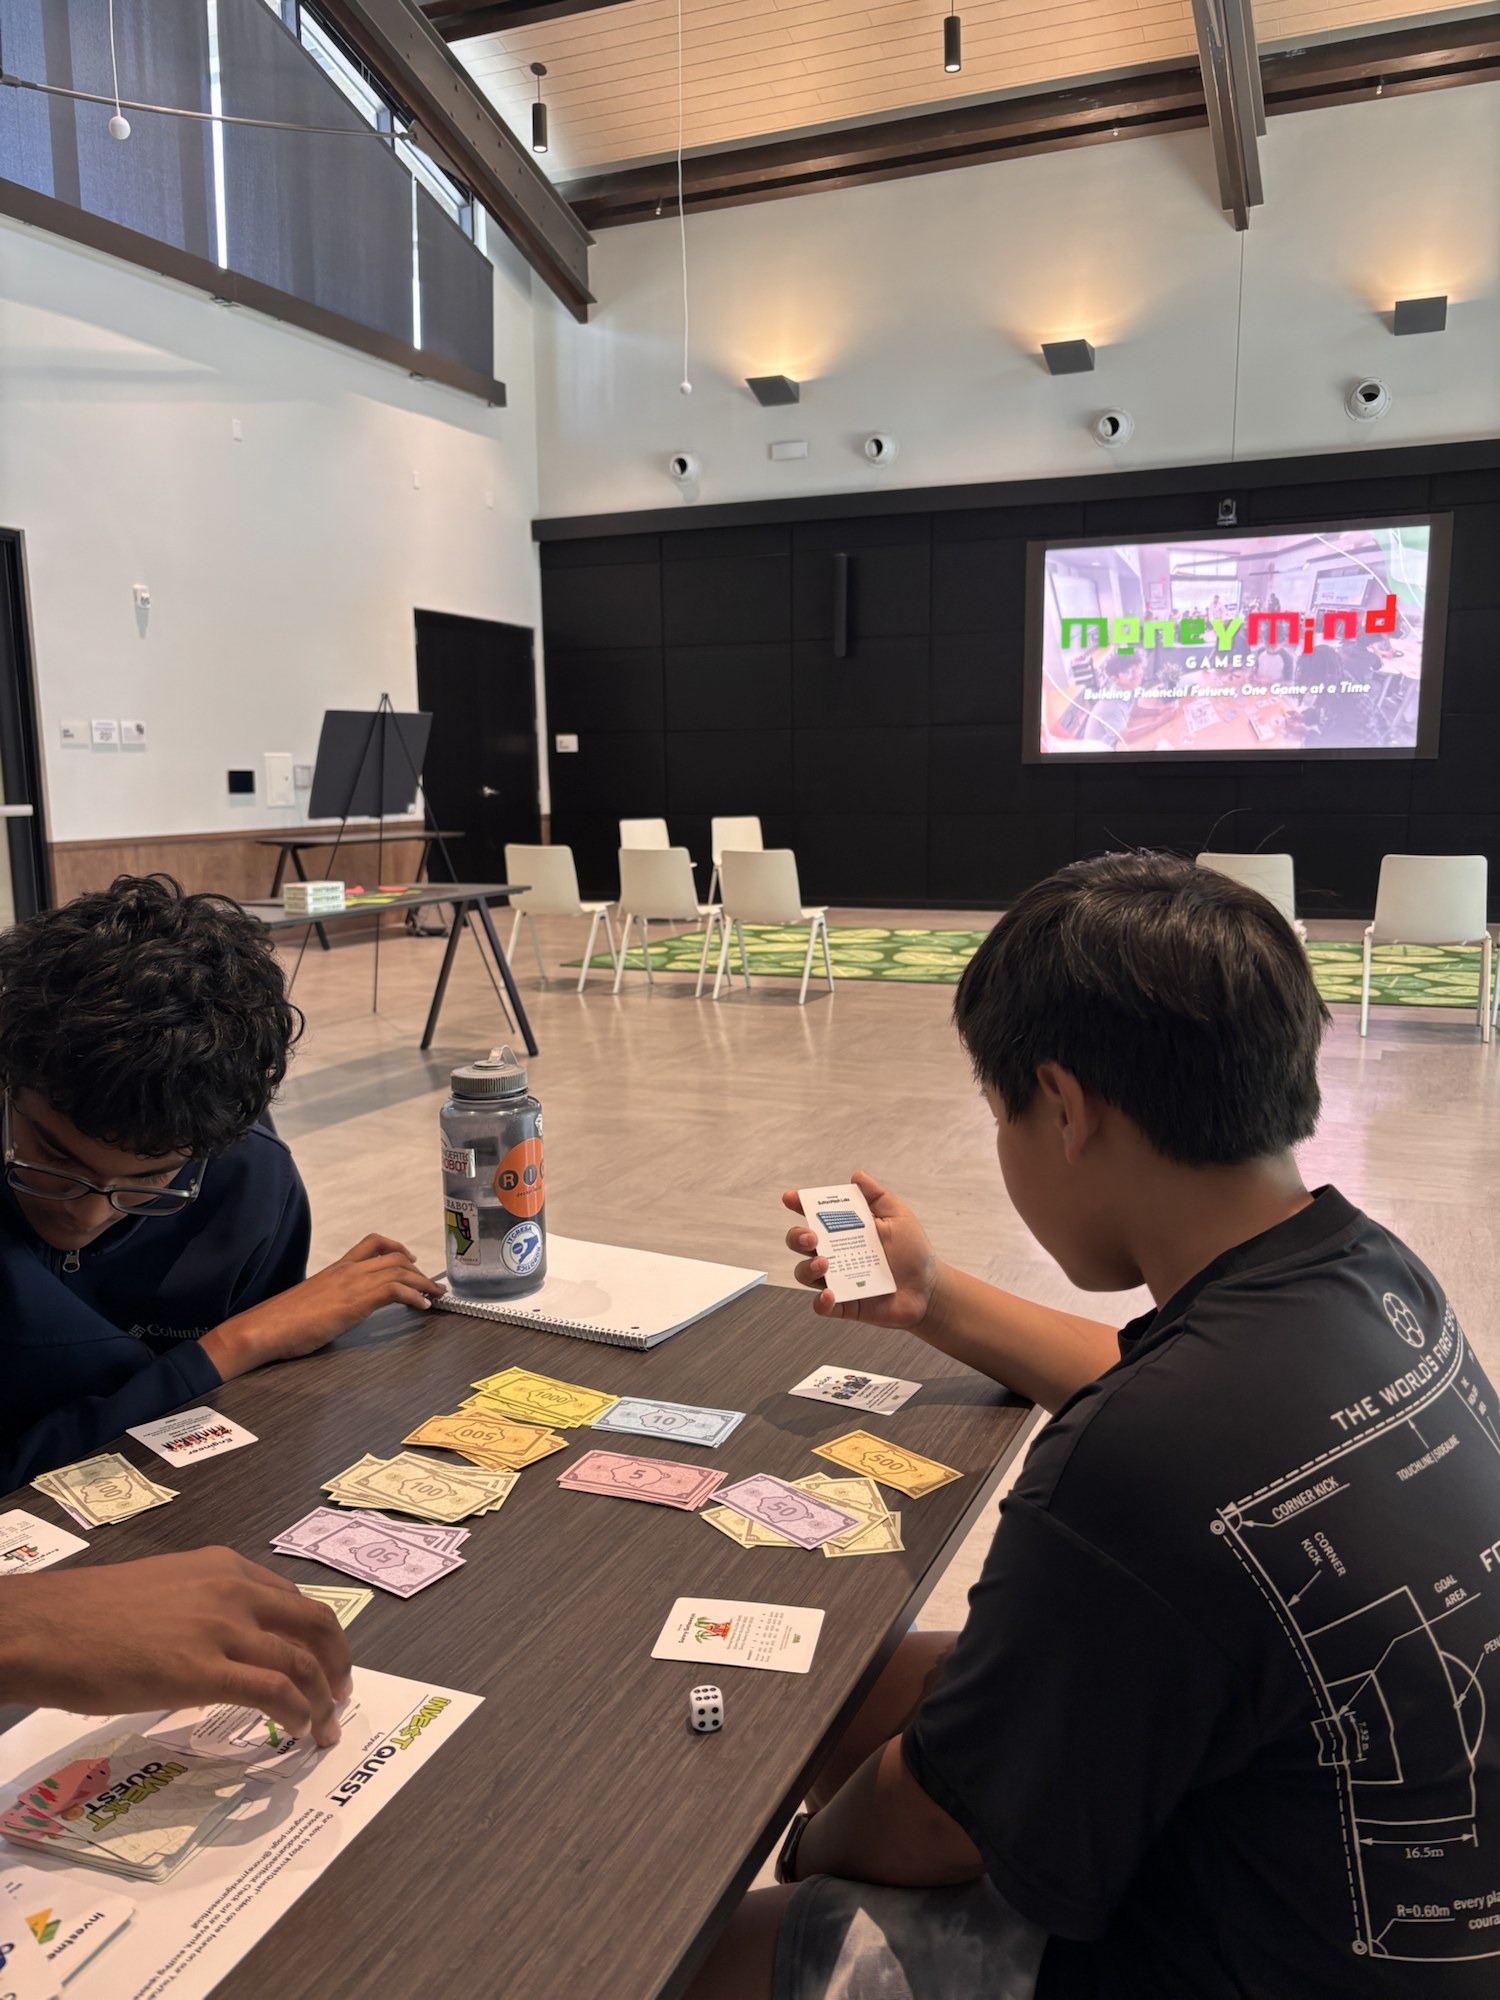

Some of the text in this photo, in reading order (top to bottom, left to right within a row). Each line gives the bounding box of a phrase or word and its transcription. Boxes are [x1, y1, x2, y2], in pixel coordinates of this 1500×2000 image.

[1186, 654, 1257, 669] GAMES
[1084, 681, 1371, 700] Building Financial Futures, One Game at a Time
[147, 1324, 209, 1339] Columbi
[535, 1391, 567, 1403] 1000
[1330, 1396, 1380, 1431] THE
[1379, 1354, 1439, 1406] WORLD'S
[653, 1415, 676, 1425] 10
[461, 1428, 498, 1440] 500
[869, 1454, 904, 1471] 500
[629, 1470, 646, 1480] 5
[96, 1481, 122, 1498] 100
[410, 1481, 443, 1496] 100
[1271, 1475, 1339, 1521] CORNER KICK
[767, 1501, 797, 1517] 50
[366, 1547, 399, 1564] 50
[1301, 1538, 1323, 1567] KICK
[1314, 1531, 1347, 1577] CORNER
[1433, 1574, 1458, 1593] GOAL
[1444, 1588, 1467, 1608] AREA
[360, 1731, 386, 1752] Layout
[329, 1745, 398, 1807] QUEST
[84, 1761, 163, 1817] QUEST
[284, 1806, 314, 1836] Instagram
[287, 1843, 303, 1858] Play
[1405, 1847, 1444, 1859] 16.5m
[230, 1882, 251, 1903] Check
[218, 1900, 232, 1913] out
[234, 1894, 253, 1912] video
[1397, 1903, 1450, 1918] R=0.60m
[1453, 1894, 1485, 1912] every
[207, 1912, 220, 1924] our
[222, 1911, 236, 1924] can
[47, 1912, 105, 1960] Investme
[213, 1922, 225, 1934] be
[193, 1932, 216, 1954] found
[155, 1947, 186, 1977] exciting
[185, 1952, 196, 1963] on
[174, 1961, 187, 1973] our
